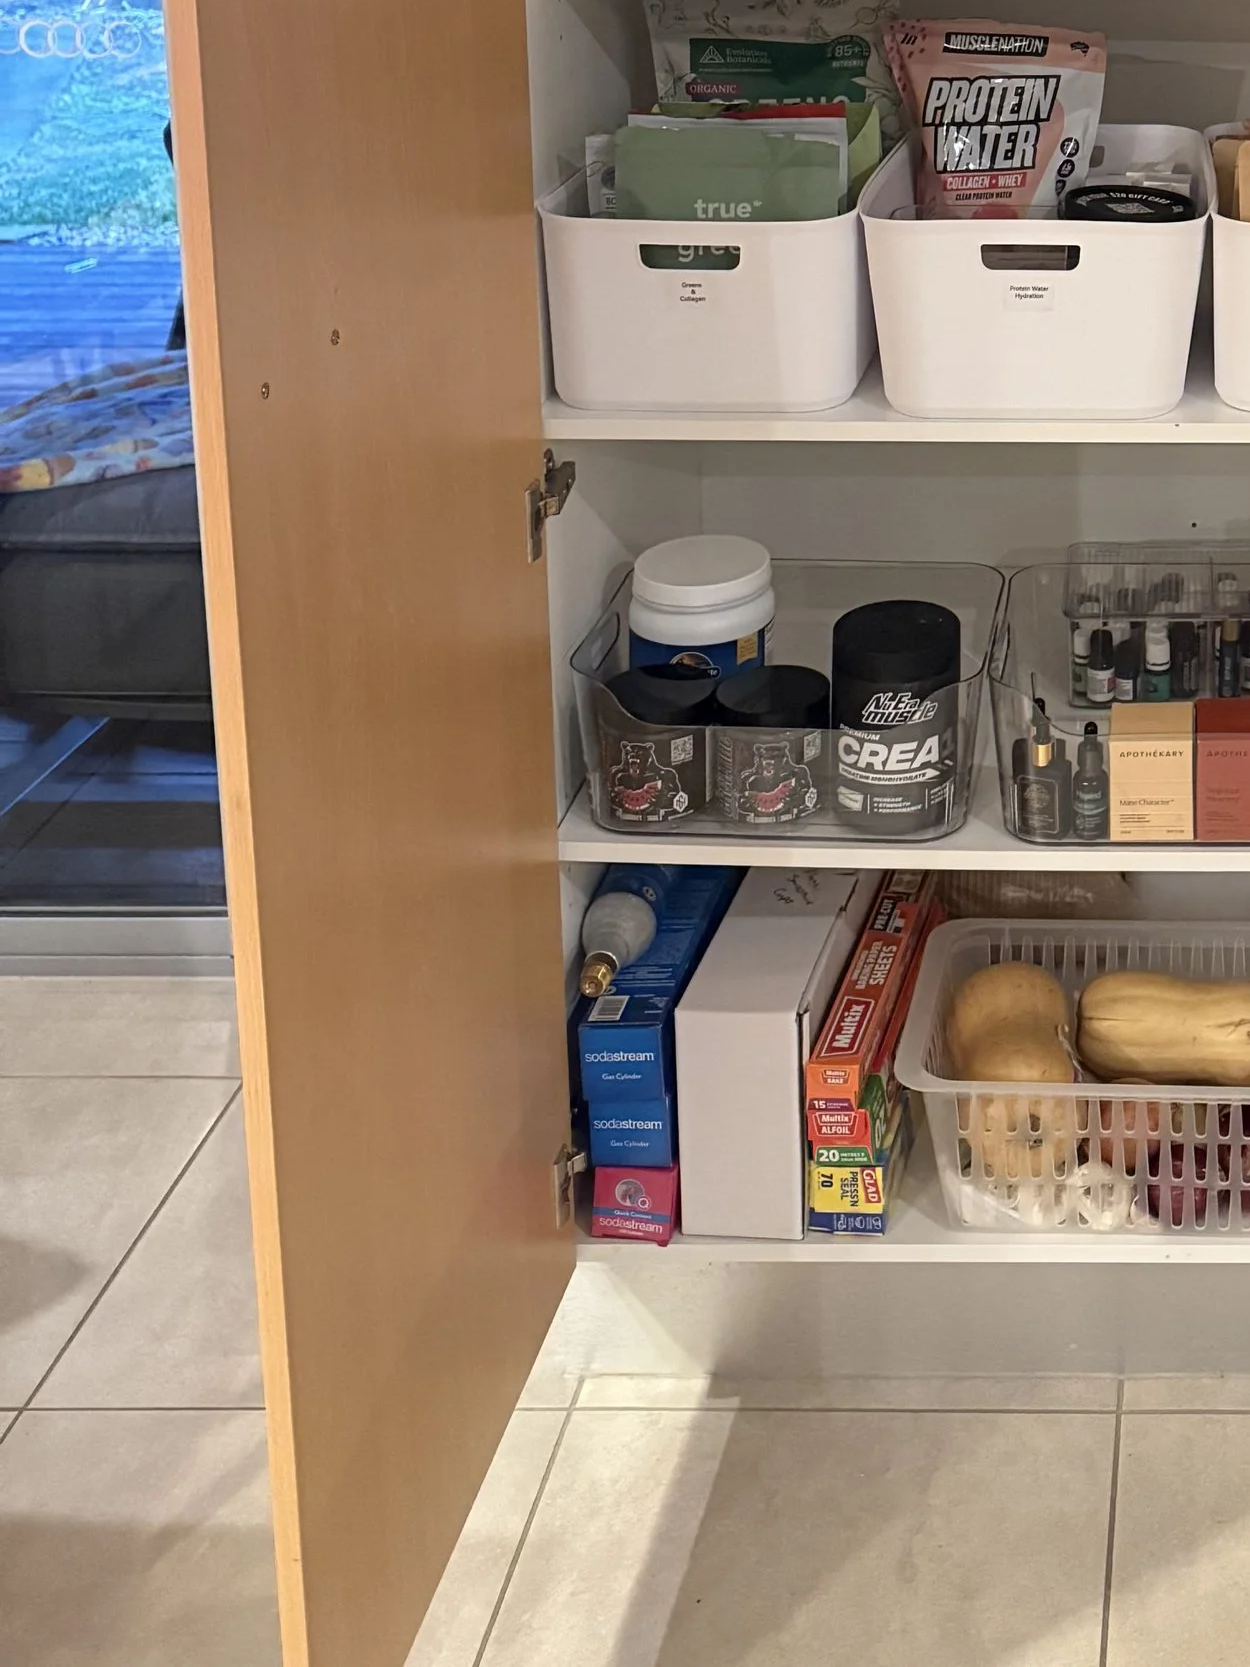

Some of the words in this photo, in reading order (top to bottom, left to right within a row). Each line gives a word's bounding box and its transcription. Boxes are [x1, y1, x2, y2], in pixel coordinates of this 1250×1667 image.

[834, 44, 861, 56] 85+
[726, 56, 771, 64] Botanicals
[690, 85, 737, 94] ORGANIC
[924, 77, 1058, 124] PROTEIN
[937, 124, 1037, 172] WATER
[946, 175, 991, 190] COLLAGEN
[998, 174, 1023, 187] WHEY
[955, 192, 971, 201] CLEAR
[972, 191, 994, 200] PROTEIN
[995, 191, 1012, 199] WATER
[693, 198, 752, 219] true
[862, 702, 938, 725] muscle
[840, 723, 880, 741] PREMIUM
[838, 735, 939, 771] CREA
[874, 898, 895, 930] PRE-CUT
[869, 945, 897, 985] SHEETS
[832, 1004, 866, 1048] Multix
[585, 1051, 654, 1062] sodastream
[616, 1073, 642, 1081] Cylinder
[813, 1100, 826, 1109] 15
[594, 1118, 662, 1130] sodastream
[821, 1114, 849, 1123] Multix
[821, 1125, 850, 1134] ALFOIL
[818, 1149, 839, 1162] 20
[821, 1173, 834, 1188] 70
[863, 1169, 880, 1202] GLAD
[840, 1177, 849, 1201] SEAL
[599, 1217, 662, 1234] sodastream
